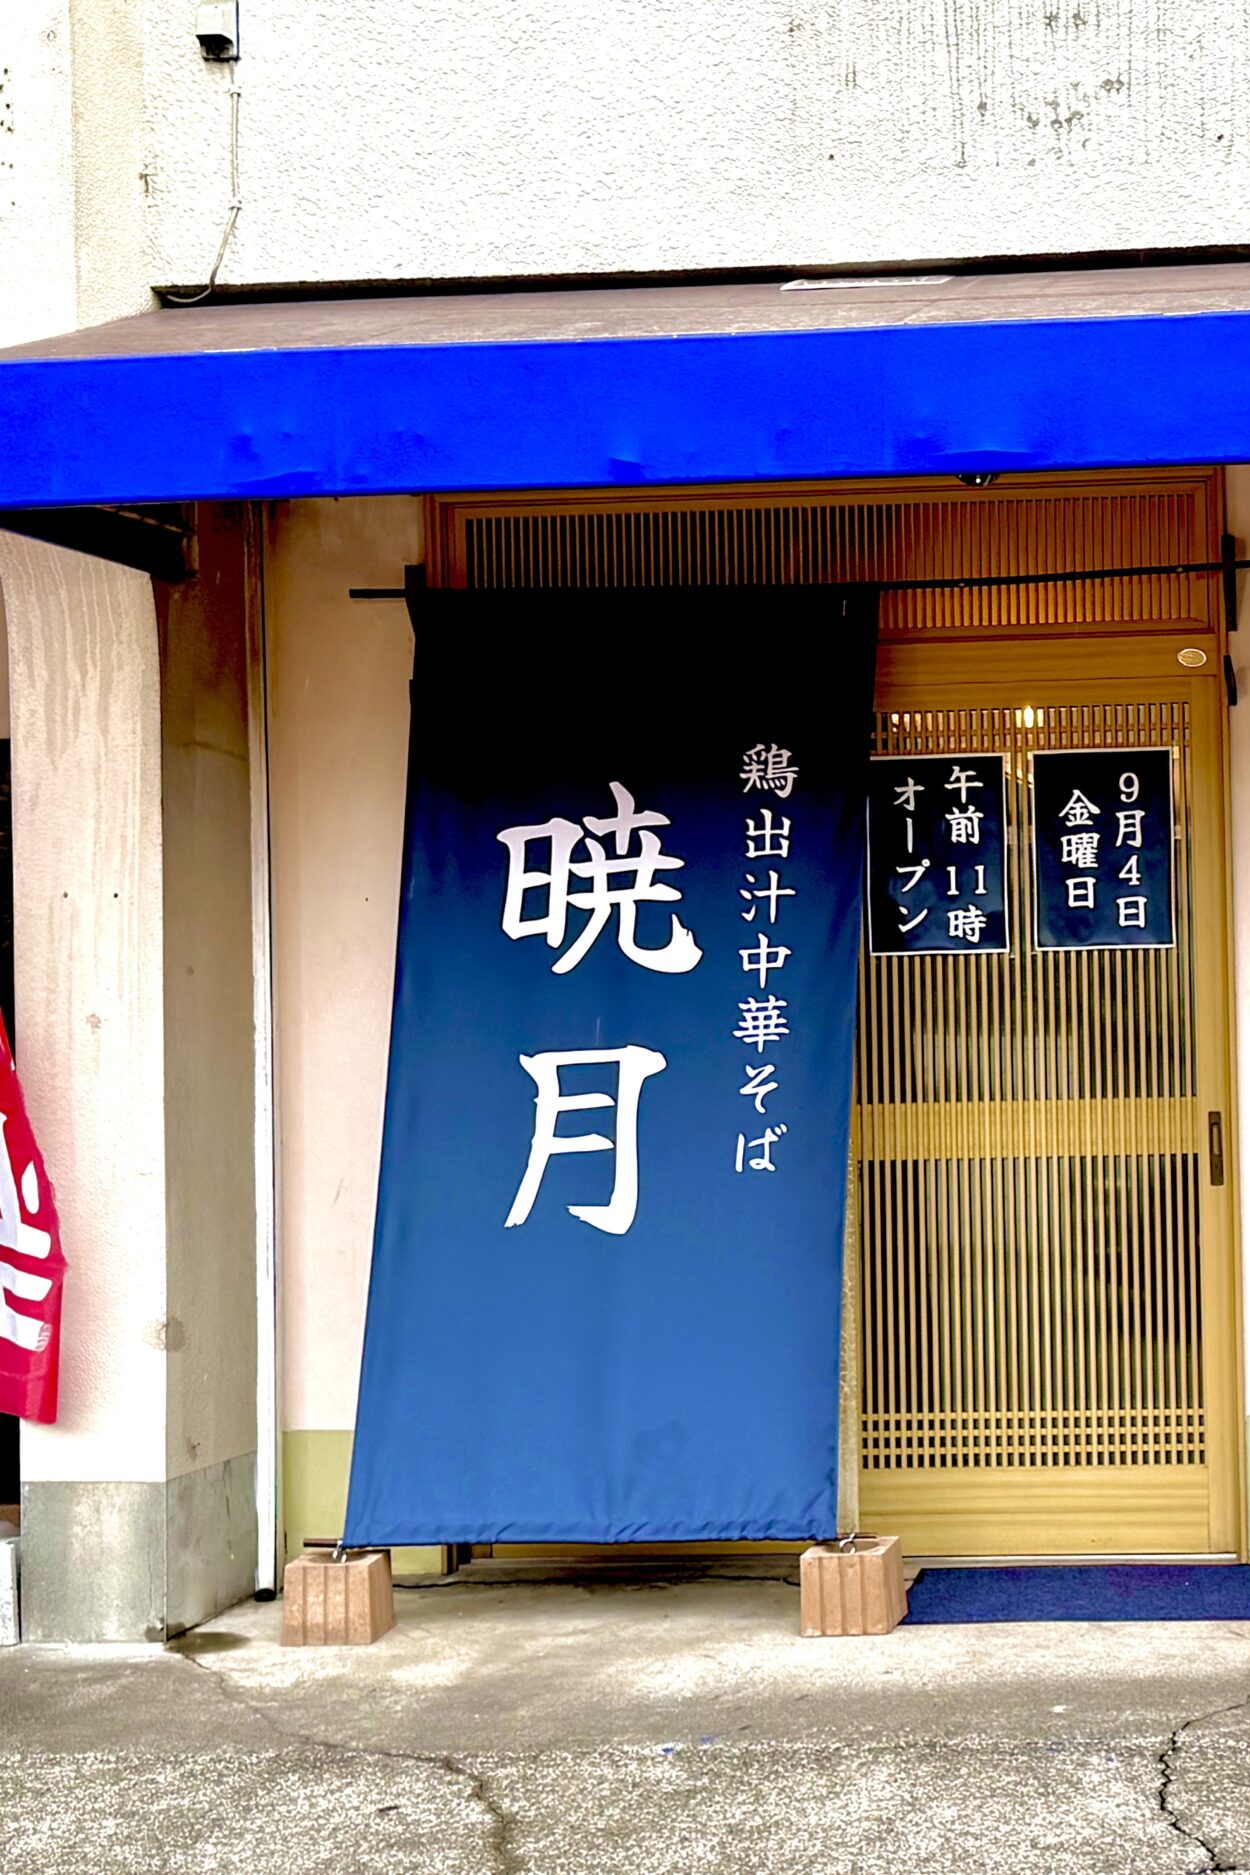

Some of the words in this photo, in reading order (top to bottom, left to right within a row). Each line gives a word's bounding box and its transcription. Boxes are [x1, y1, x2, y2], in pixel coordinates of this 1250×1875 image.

[893, 777, 931, 934] オープン
[943, 766, 988, 943] 午前11時
[1058, 789, 1101, 910] 金曜日
[1115, 772, 1147, 929] 9月4日
[496, 781, 703, 1235] 暁月
[733, 742, 799, 1174] 鶏出汁中華そば
